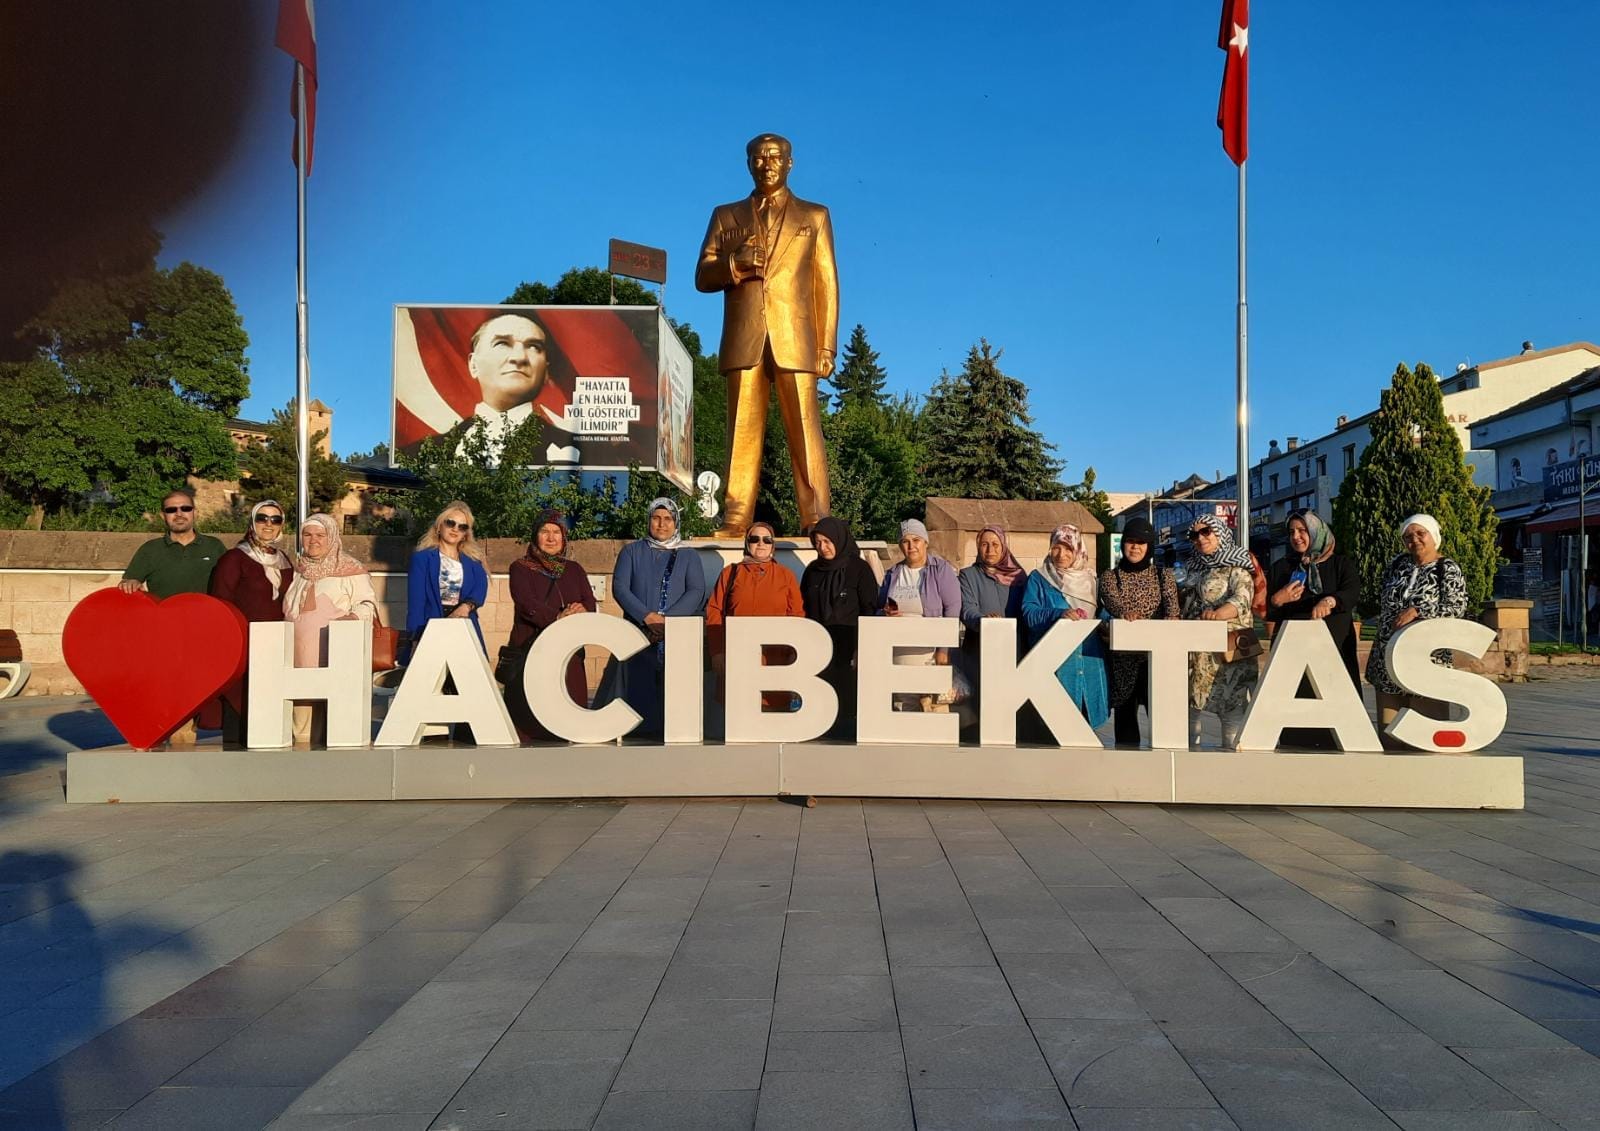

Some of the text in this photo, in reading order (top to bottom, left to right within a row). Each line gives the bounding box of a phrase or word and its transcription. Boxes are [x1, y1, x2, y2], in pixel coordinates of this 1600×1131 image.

[578, 392, 626, 404] EN HAKİKİ
[567, 405, 637, 418] YOL GÖSTERİCİ
